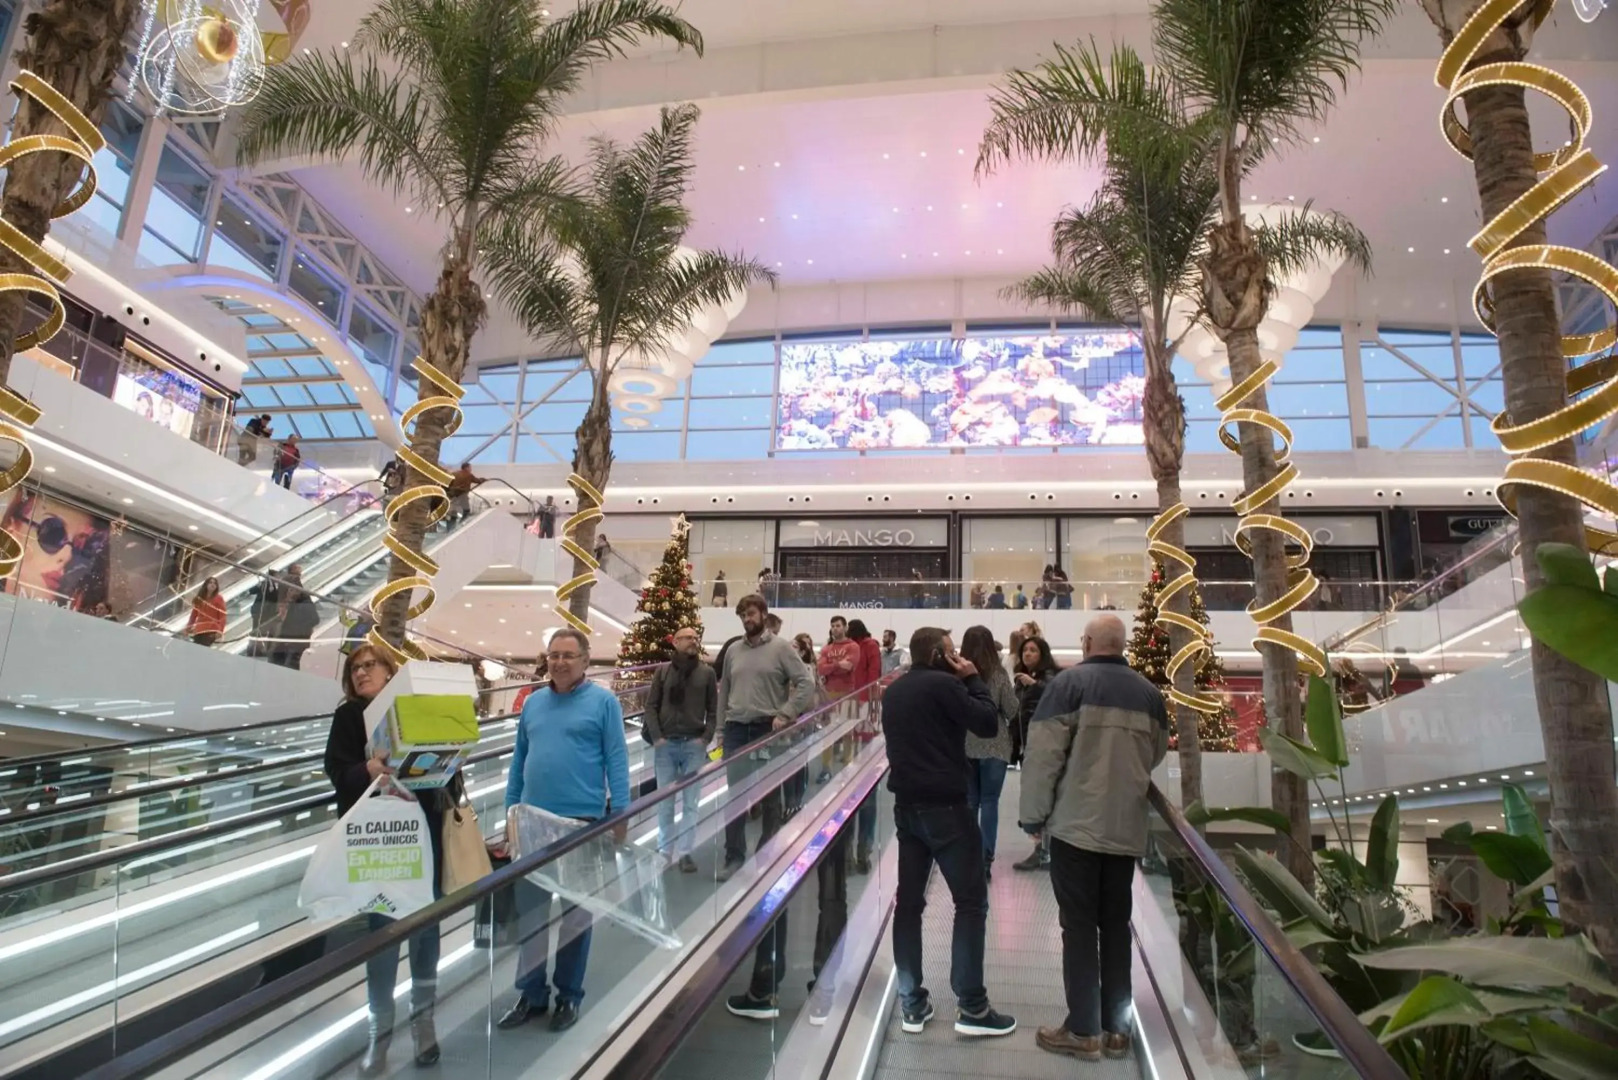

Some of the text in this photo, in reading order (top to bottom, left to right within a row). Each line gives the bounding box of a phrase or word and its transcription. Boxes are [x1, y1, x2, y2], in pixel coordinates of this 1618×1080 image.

[814, 529, 915, 547] MANGO
[840, 601, 884, 610] MANGO
[346, 819, 419, 836] En CALIDAD
[346, 833, 418, 847] somos ÚNICOS
[348, 849, 420, 867] En PRECIO
